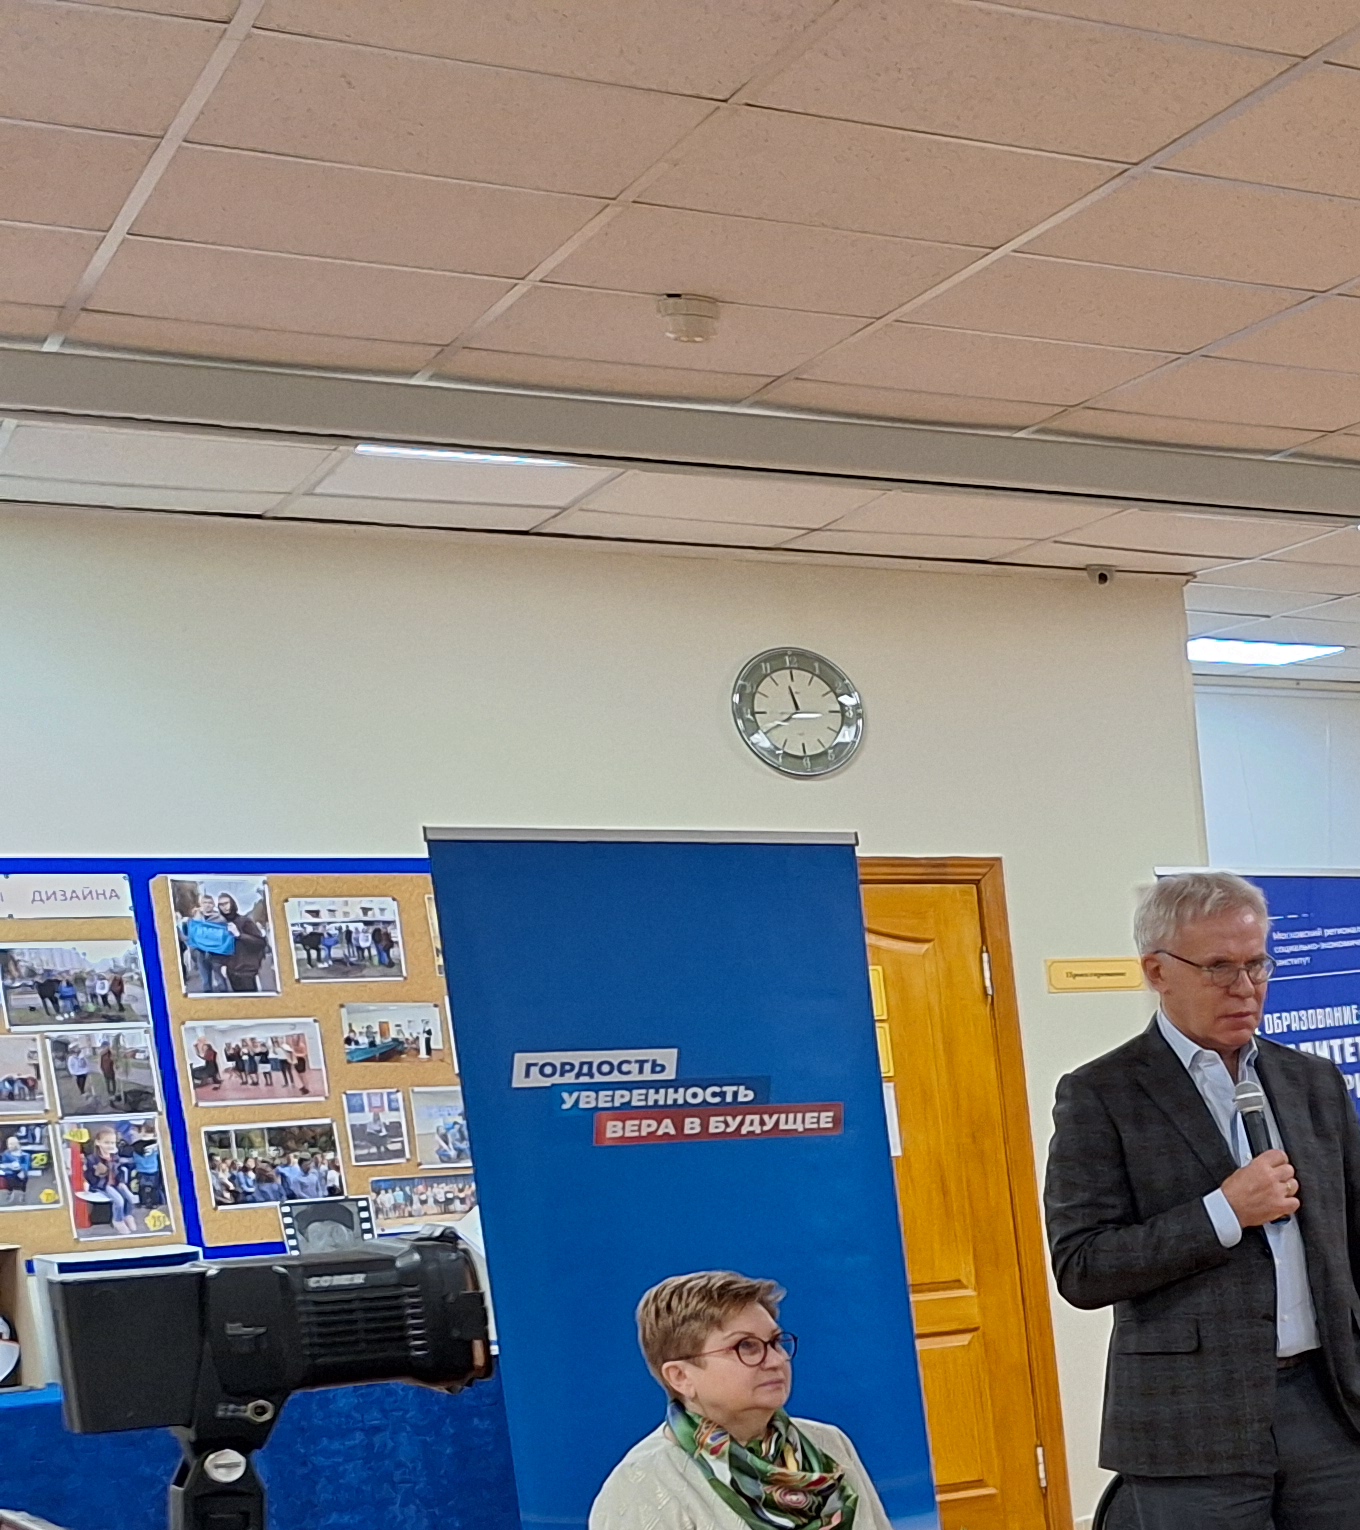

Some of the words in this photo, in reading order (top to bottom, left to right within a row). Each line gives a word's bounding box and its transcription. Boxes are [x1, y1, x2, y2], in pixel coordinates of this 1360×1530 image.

[31, 886, 121, 905] ДИЗАЙНА
[523, 1058, 667, 1080] ГОРДОСТЬ
[560, 1085, 755, 1110] УВЕРЕННОСТЬ
[605, 1118, 677, 1138] ВЕРА
[683, 1117, 702, 1134] В
[708, 1111, 835, 1134] БУДУЩЕЕ
